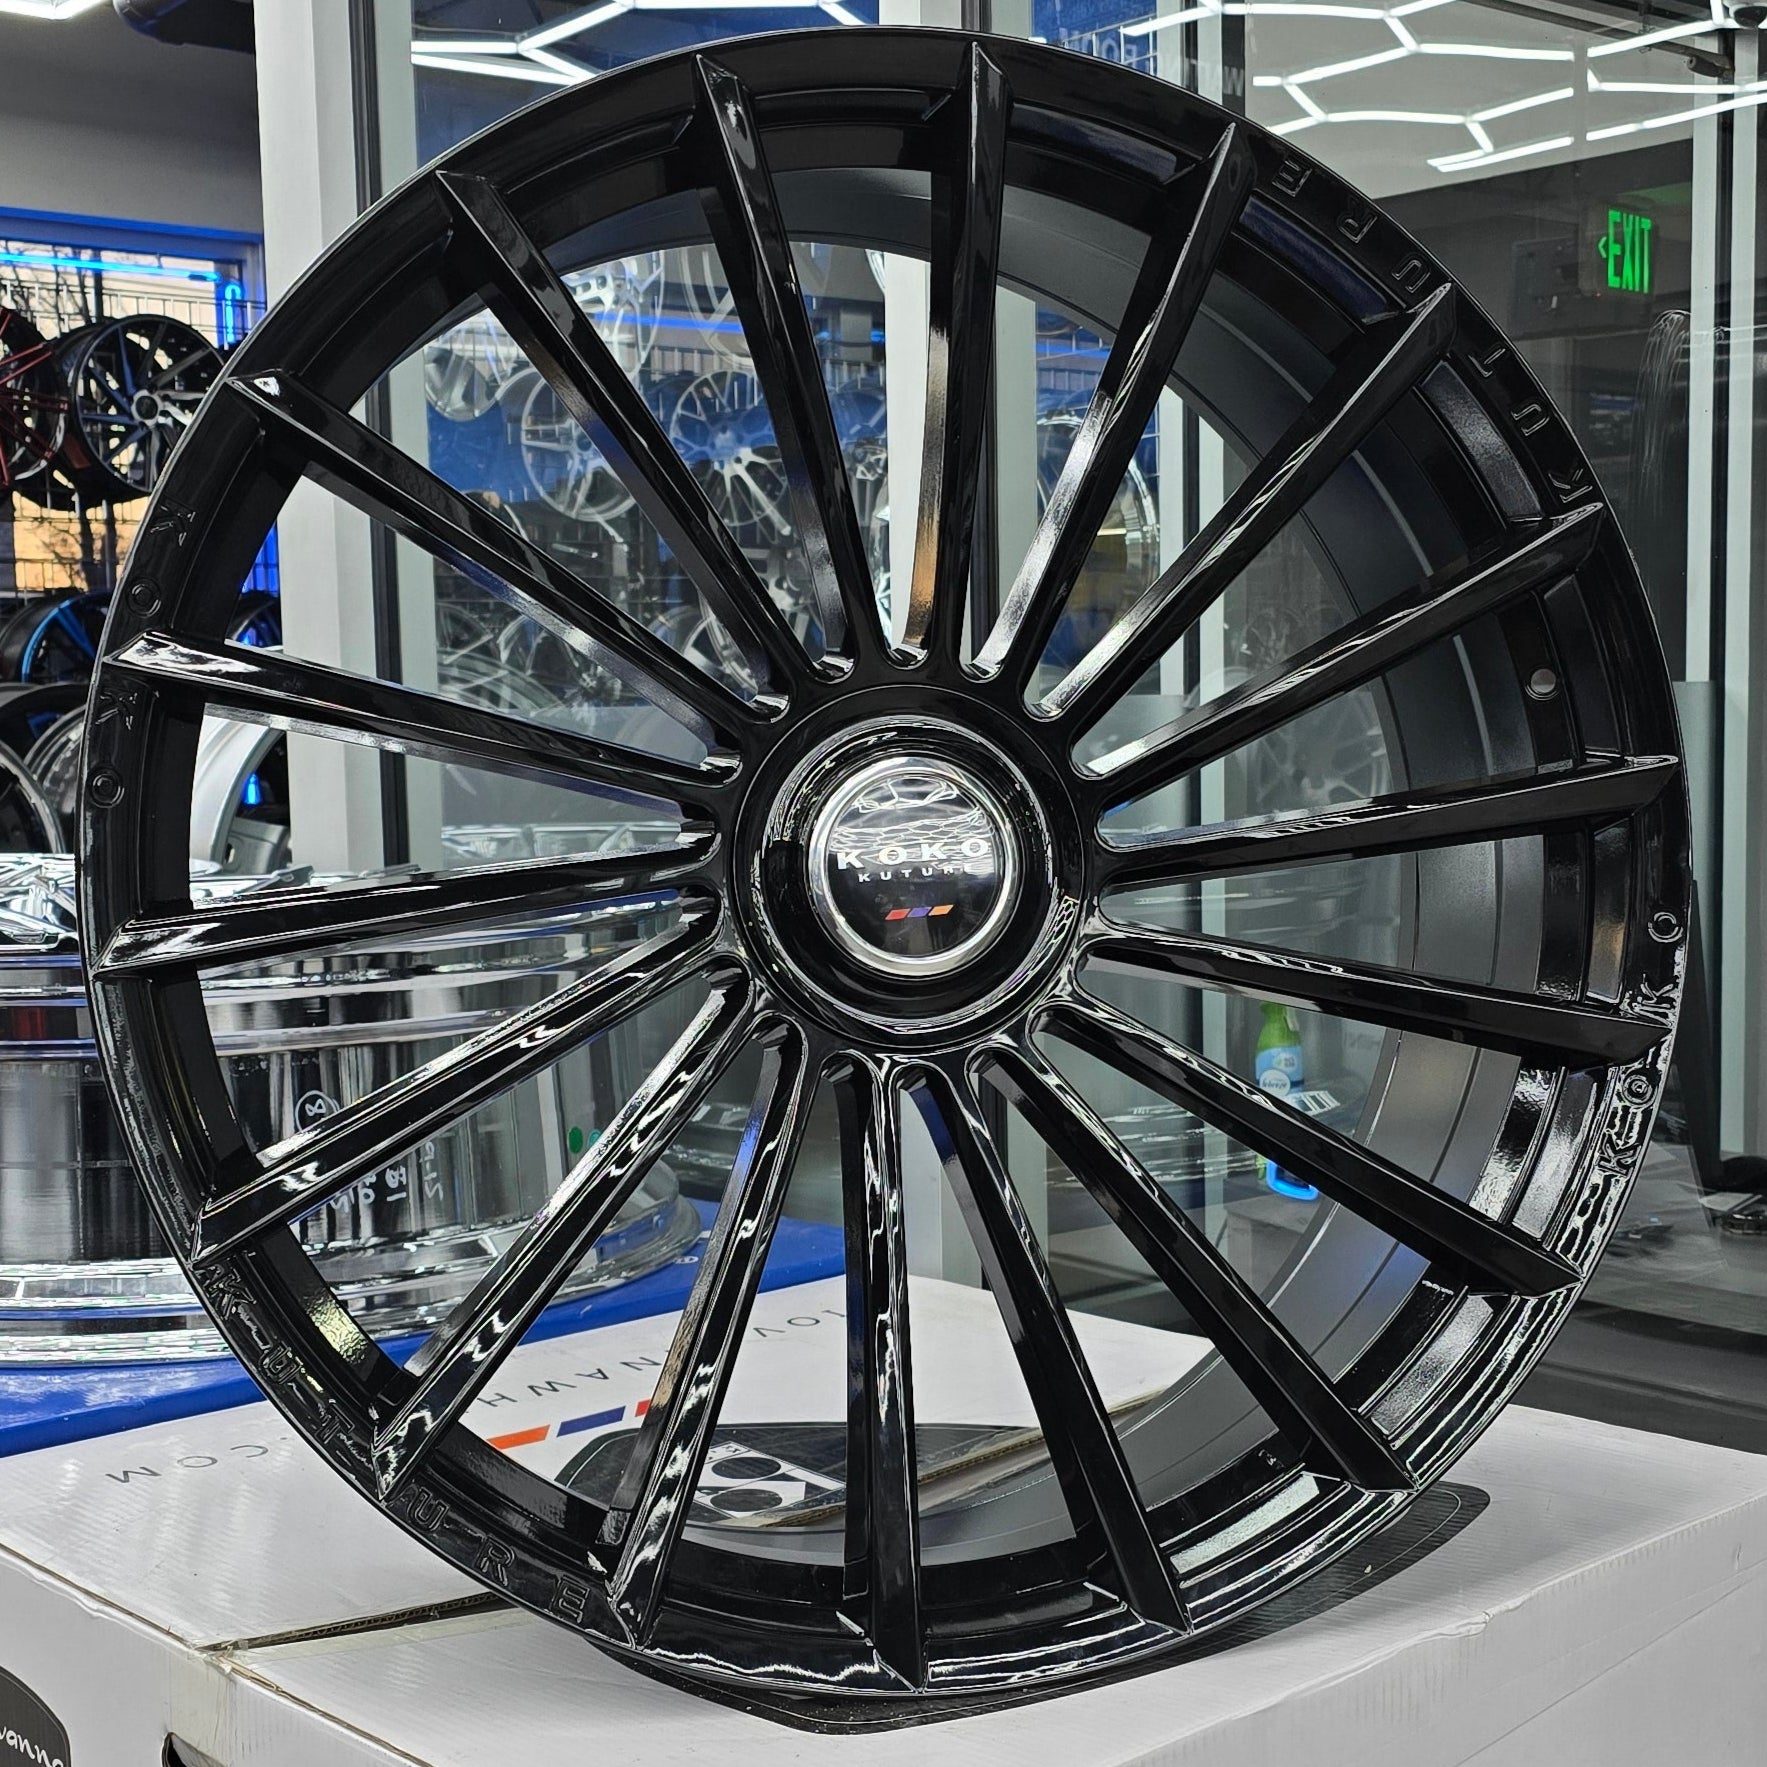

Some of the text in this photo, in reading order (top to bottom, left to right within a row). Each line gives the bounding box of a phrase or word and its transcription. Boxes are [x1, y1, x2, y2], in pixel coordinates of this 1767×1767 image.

[1607, 209, 1652, 293] EXIT
[836, 838, 990, 870] KOKO
[858, 862, 972, 883] KUTURE
